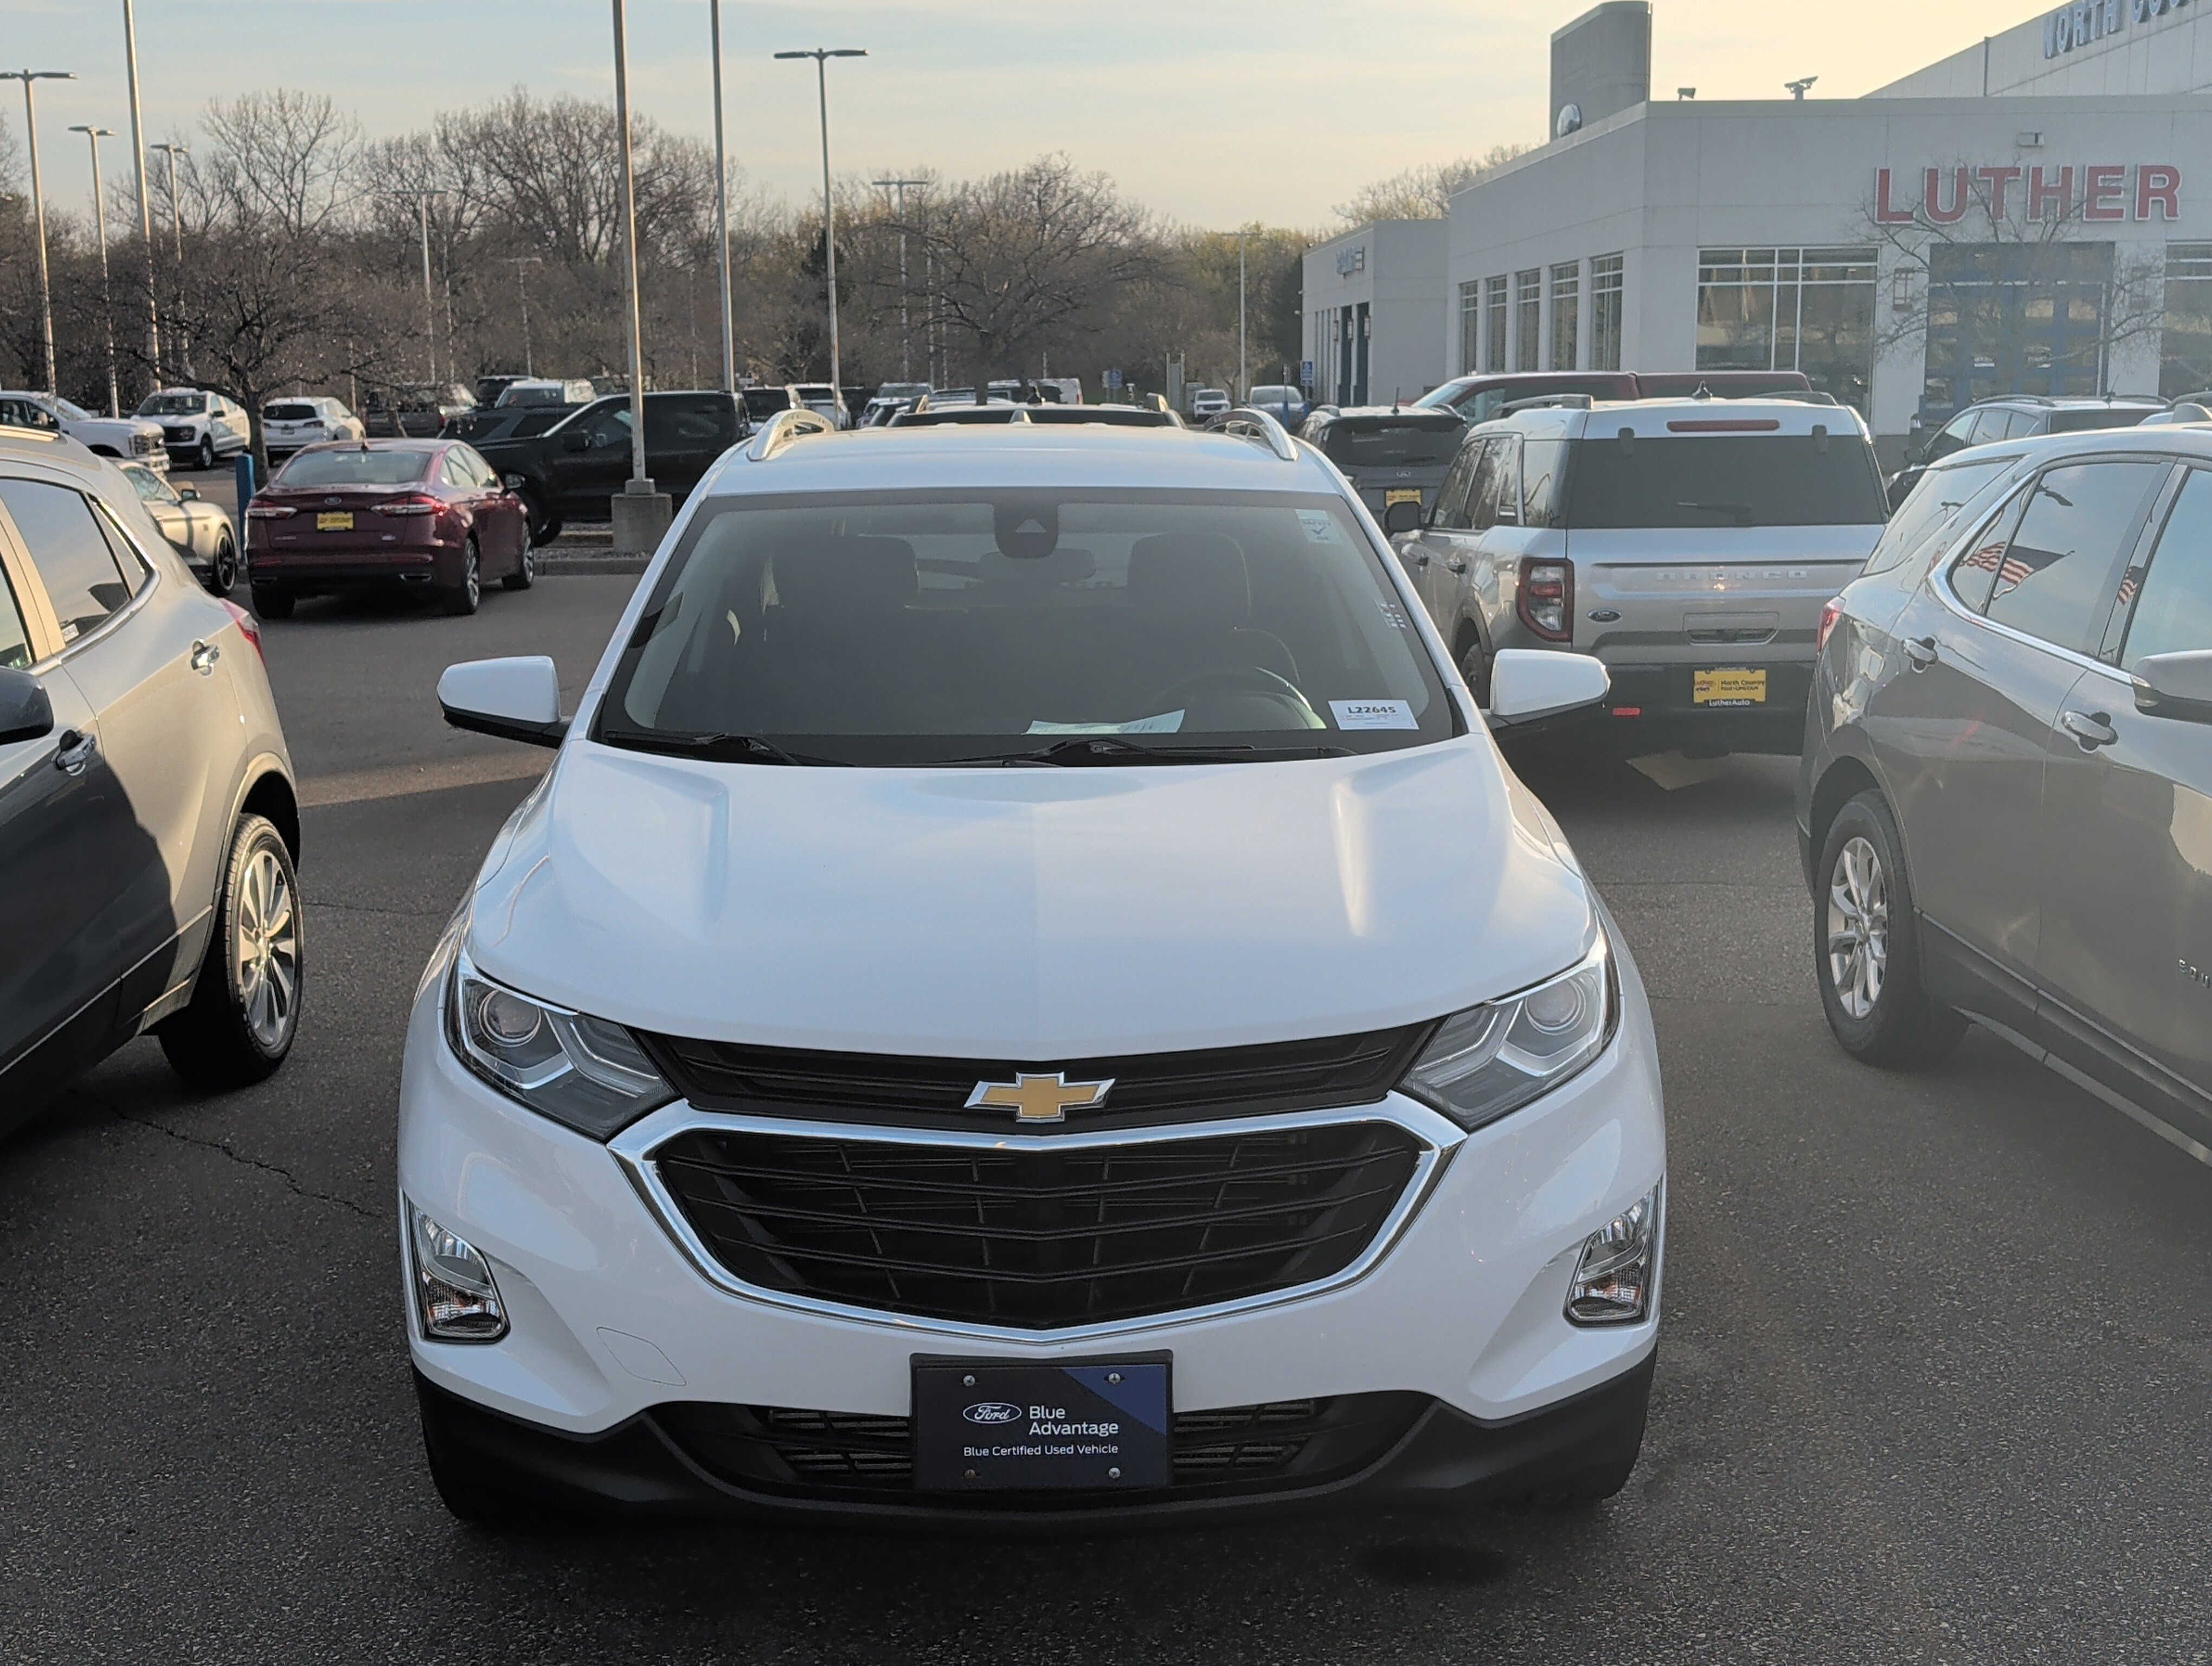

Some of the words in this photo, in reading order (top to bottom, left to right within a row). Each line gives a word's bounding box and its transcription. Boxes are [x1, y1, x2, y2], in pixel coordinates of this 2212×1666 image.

[2043, 0, 2124, 59] NORTH
[1874, 164, 2182, 225] LUTHER
[974, 1405, 1011, 1421] Ford
[1030, 1406, 1066, 1419] Blue
[1029, 1421, 1119, 1437] Advantage
[963, 1446, 989, 1456] Blue
[992, 1445, 1041, 1456] Certified
[1045, 1445, 1074, 1455] Used
[1077, 1444, 1118, 1454] Vehicle
